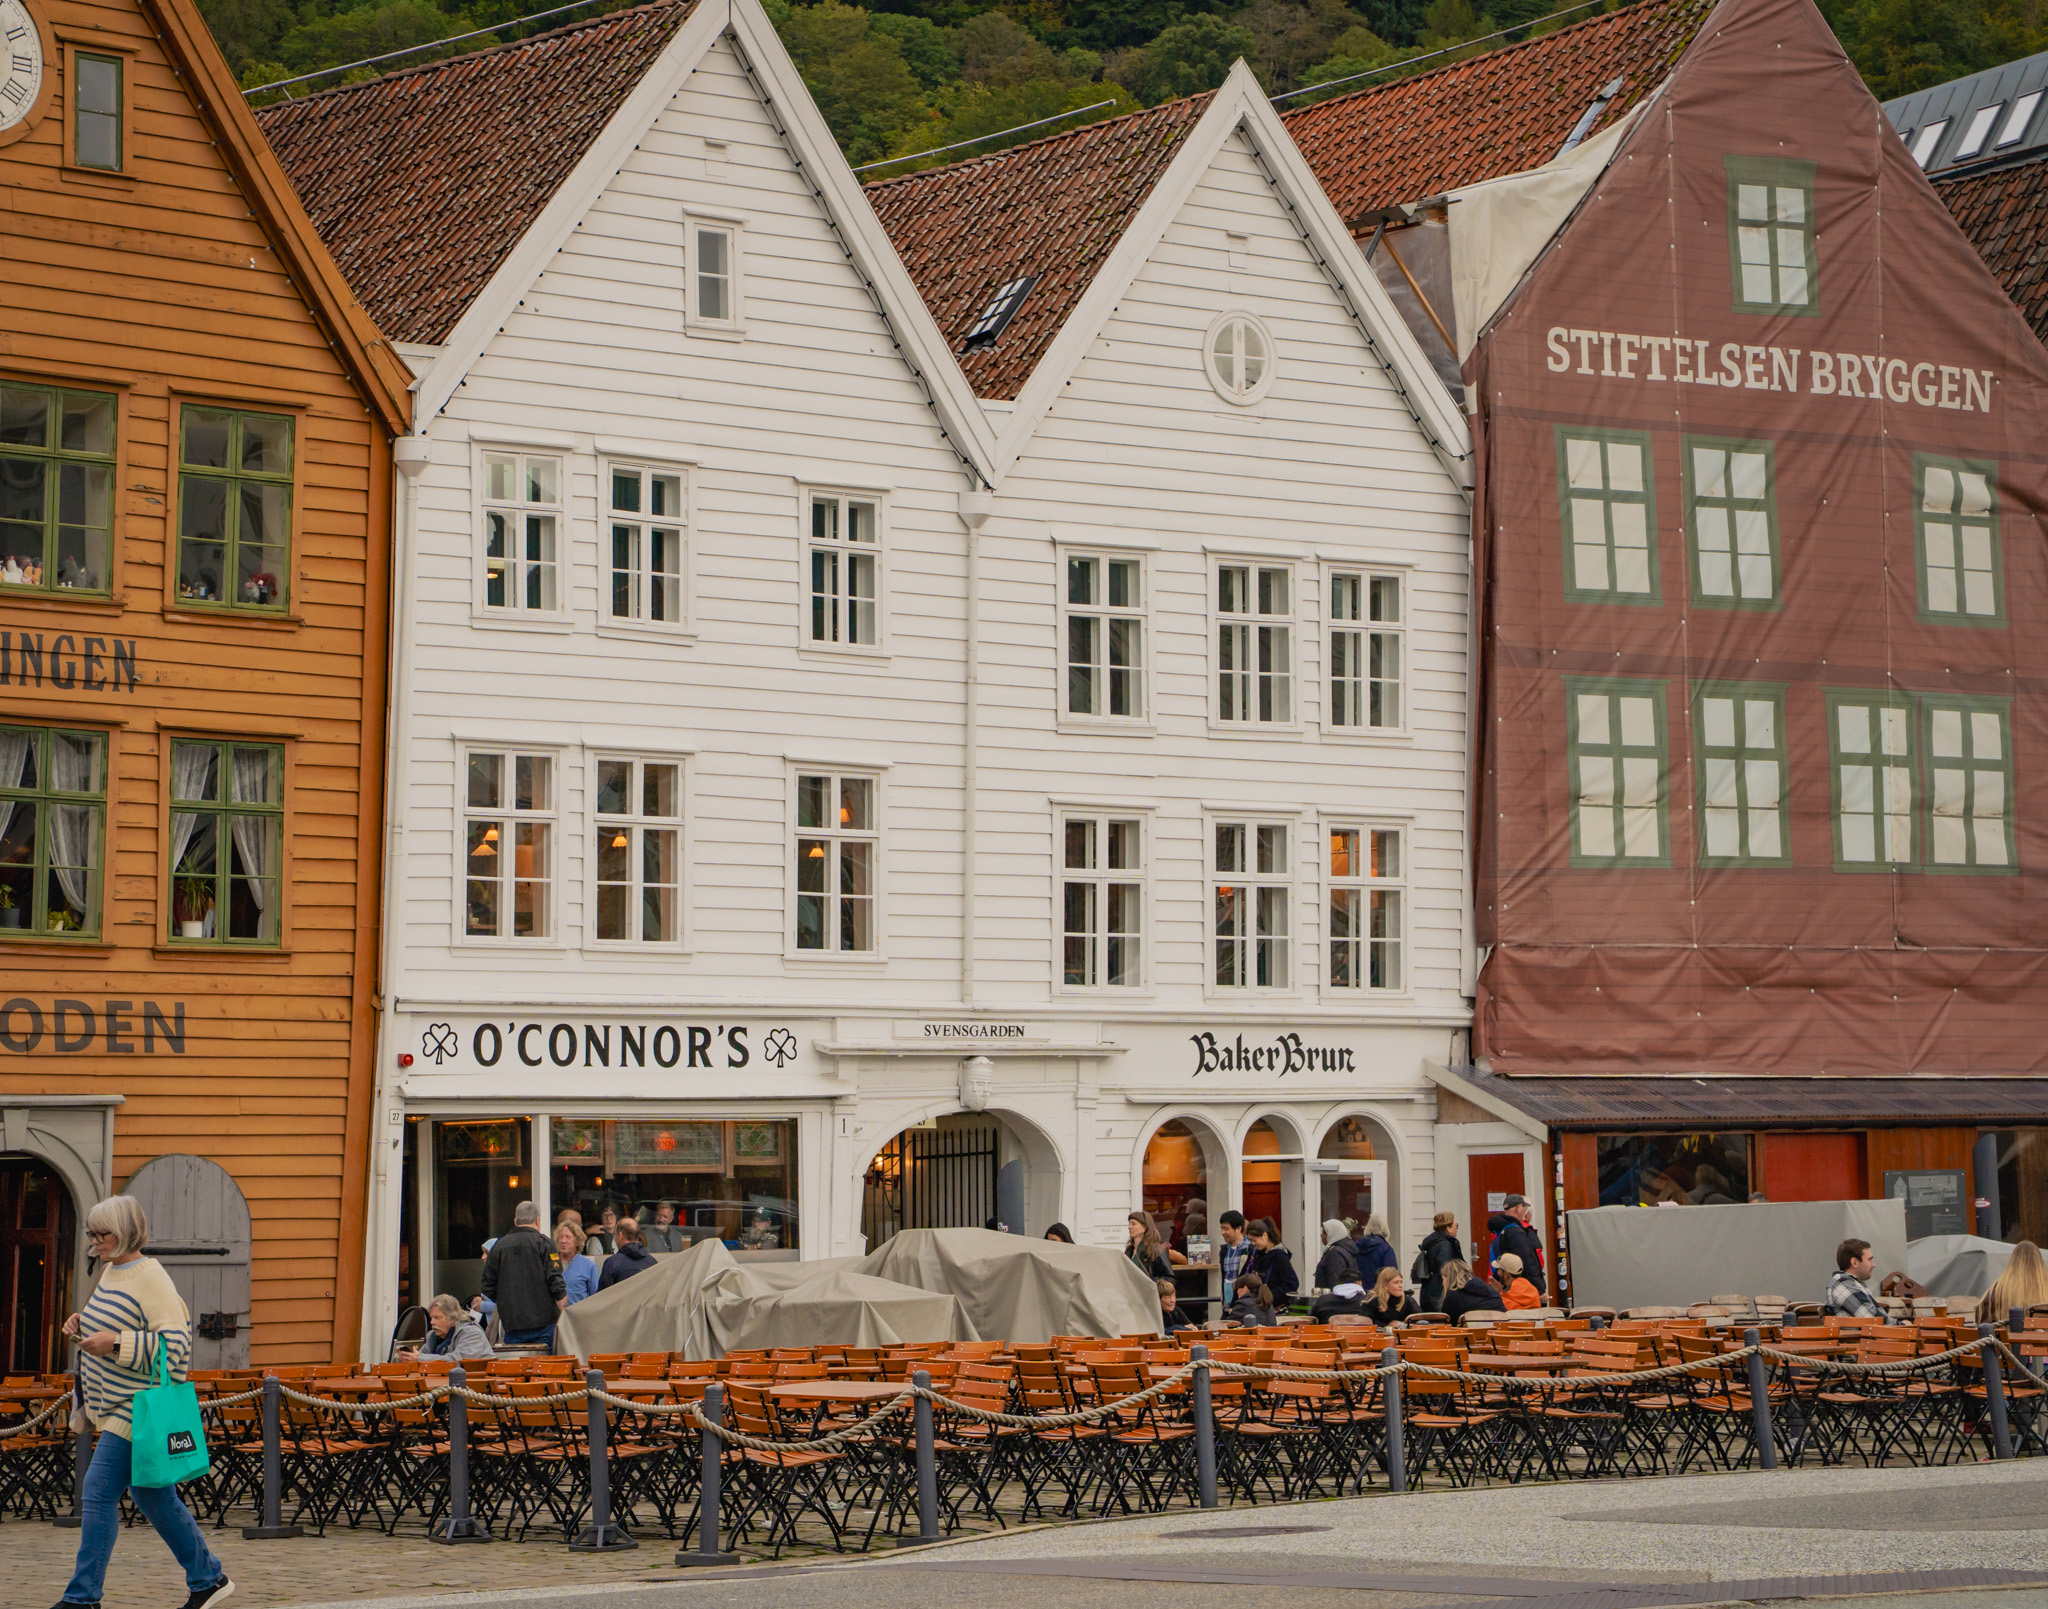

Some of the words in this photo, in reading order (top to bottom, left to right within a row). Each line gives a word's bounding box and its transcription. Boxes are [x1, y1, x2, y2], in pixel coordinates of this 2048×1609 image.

[1547, 327, 1801, 393] STIFTELSEN
[1810, 351, 1994, 413] BRYGGEN
[0, 631, 137, 694] INGEN
[0, 997, 186, 1054] ODEN
[473, 1022, 751, 1068] O'CONNOR'S
[392, 1112, 400, 1121] 27
